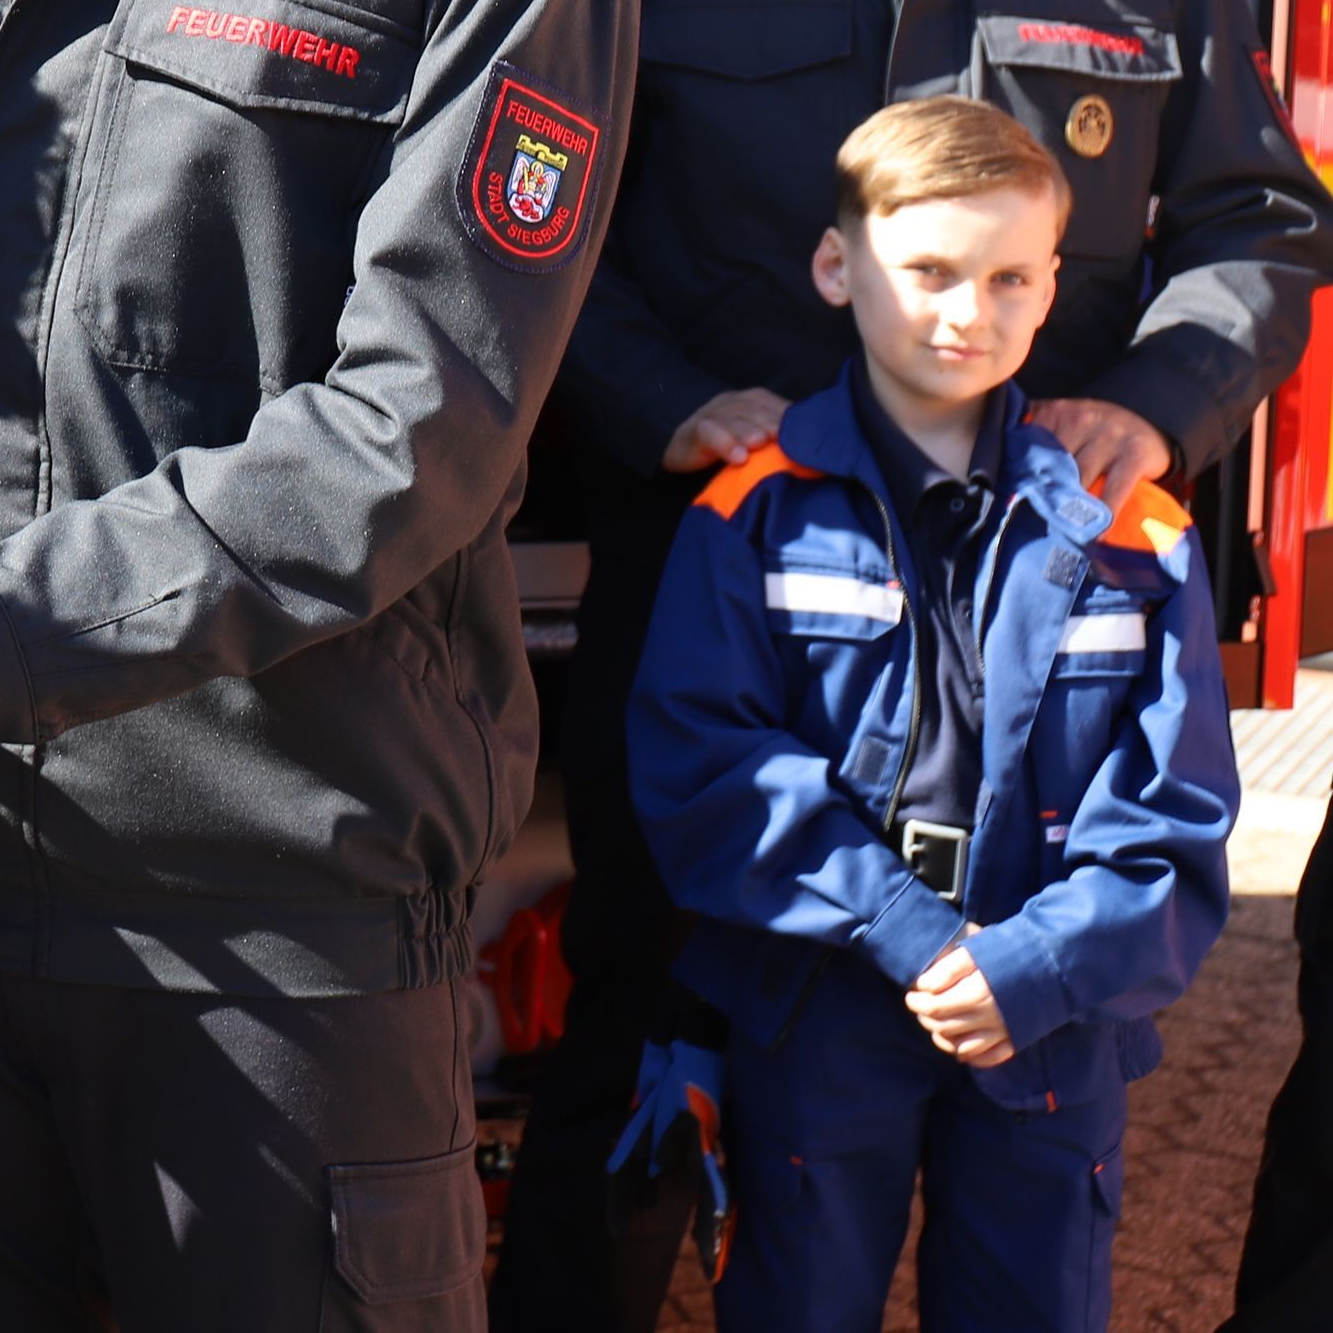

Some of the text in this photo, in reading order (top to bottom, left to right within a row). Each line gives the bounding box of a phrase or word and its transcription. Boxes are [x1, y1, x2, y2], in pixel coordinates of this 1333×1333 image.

[165, 5, 362, 79] FEUERWEHR
[506, 100, 588, 156] FEUERWEHR
[486, 171, 571, 246] STADT SIEGBURG
